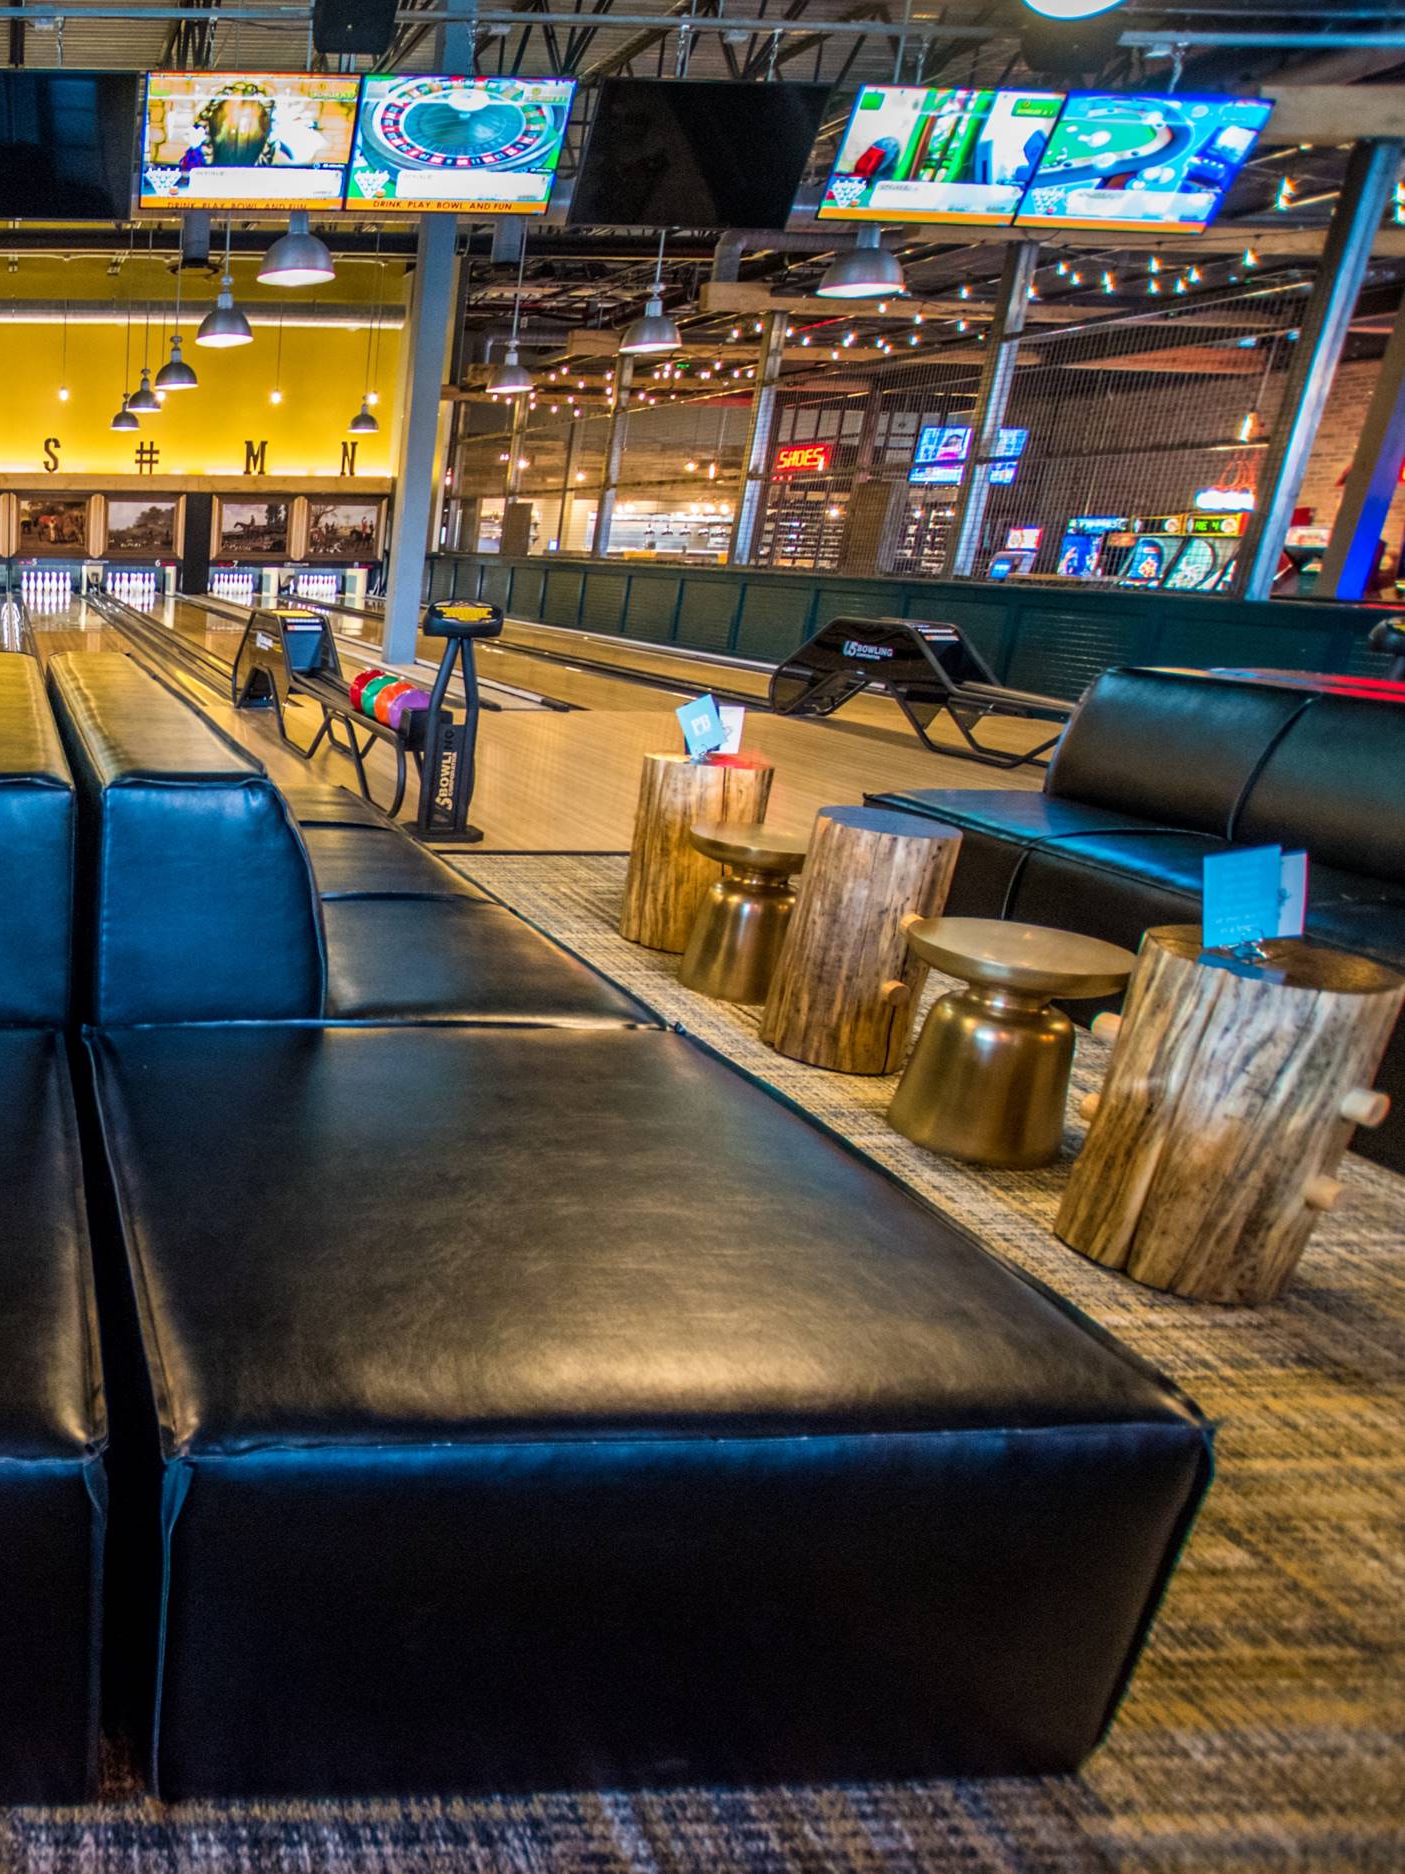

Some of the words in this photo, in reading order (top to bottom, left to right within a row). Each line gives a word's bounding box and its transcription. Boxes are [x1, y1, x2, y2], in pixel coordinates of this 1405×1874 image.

[372, 200, 402, 208] DRINK
[436, 201, 464, 209] BOWL
[469, 202, 491, 210] AND
[493, 202, 513, 210] FUN
[776, 447, 825, 469] SHOES
[856, 642, 894, 657] BOWLING
